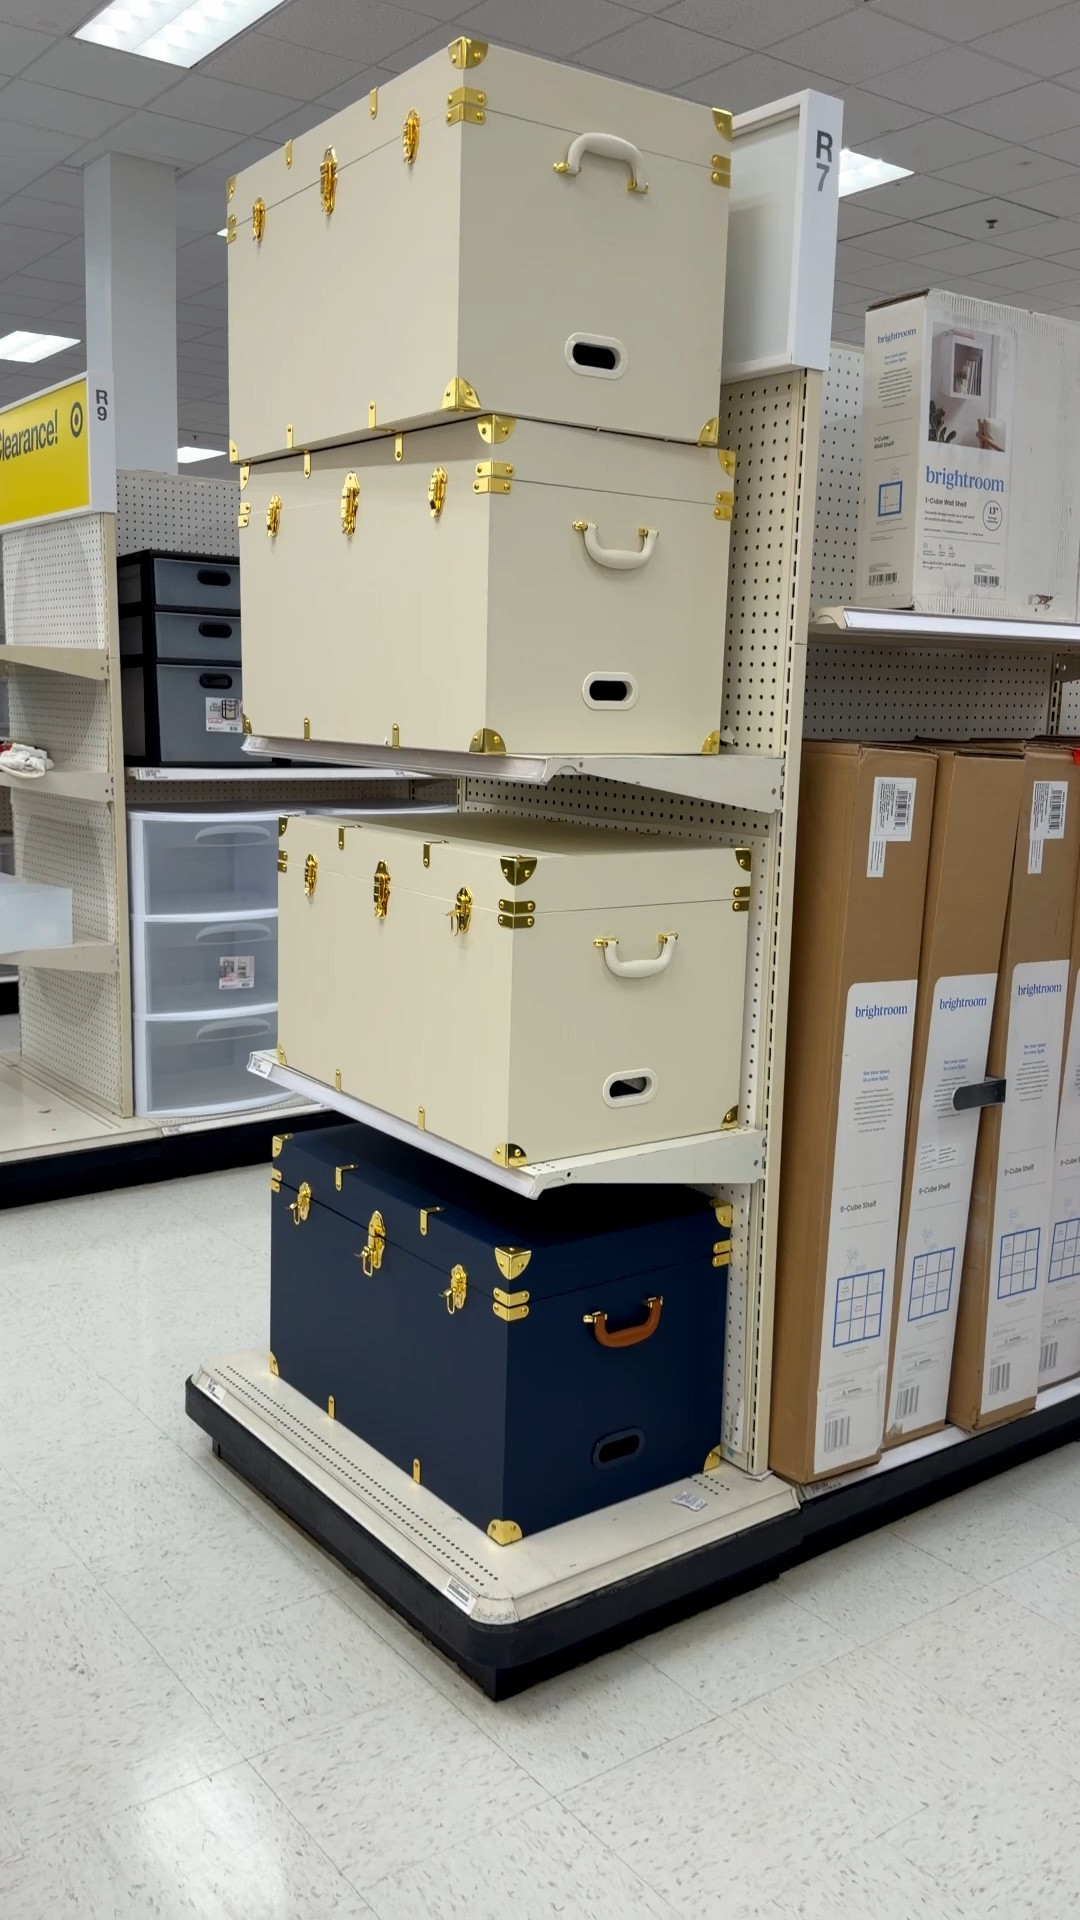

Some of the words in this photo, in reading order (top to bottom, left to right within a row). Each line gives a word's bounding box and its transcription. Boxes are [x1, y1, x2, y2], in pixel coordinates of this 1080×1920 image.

[816, 130, 833, 163] R
[816, 162, 830, 192] 7
[877, 328, 917, 344] brightroom
[95, 389, 108, 405] R
[96, 406, 108, 421] 9
[0, 408, 58, 462] learance!
[926, 465, 1004, 493] brightroom
[925, 496, 943, 505] 1-Cube
[944, 499, 954, 507] Wall
[955, 500, 967, 508] Shelf
[1017, 984, 1063, 998] brightroom
[855, 1004, 908, 1020] brightroom
[939, 996, 987, 1012] brightroom
[1022, 1163, 1034, 1173] Shelf
[938, 1182, 950, 1191] Shelf
[862, 1200, 876, 1209] Shelf
